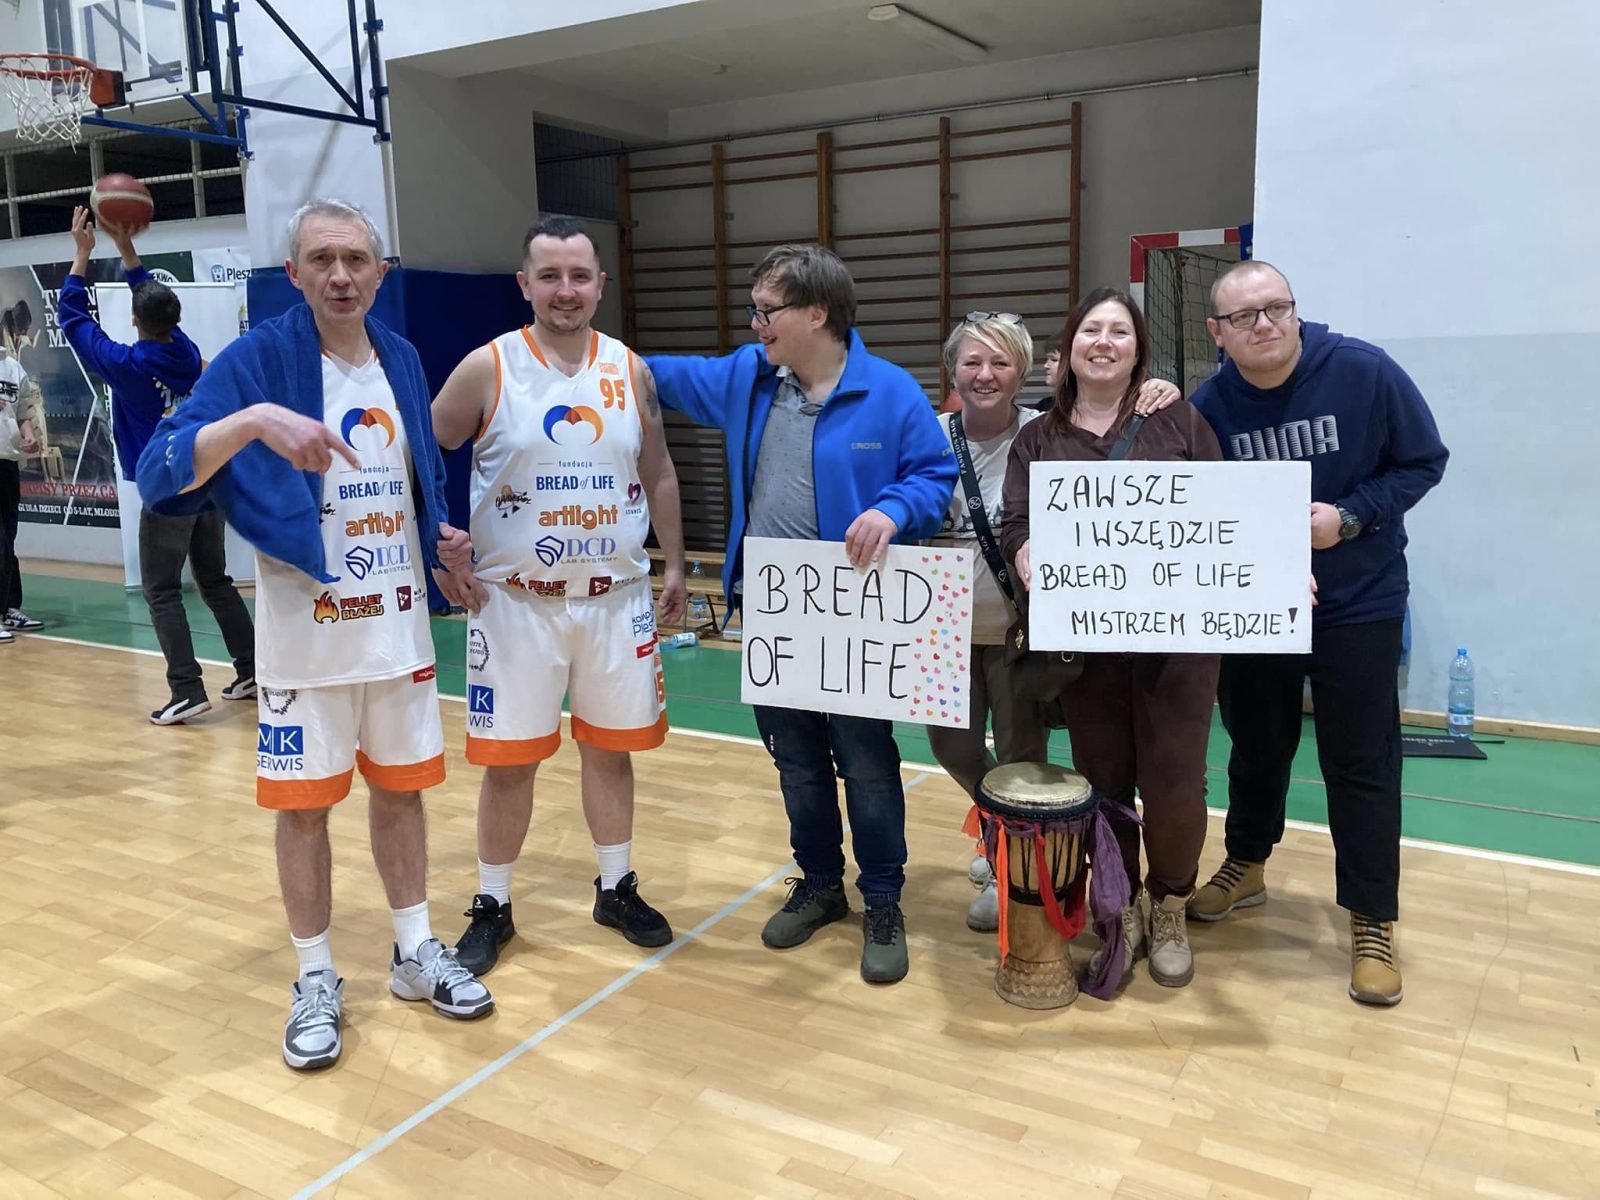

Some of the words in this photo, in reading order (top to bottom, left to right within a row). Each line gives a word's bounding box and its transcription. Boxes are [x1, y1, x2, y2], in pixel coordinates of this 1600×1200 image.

[227, 268, 251, 281] Plesz
[240, 321, 248, 330] AT
[599, 377, 625, 411] 95
[1229, 414, 1340, 461] PUMA
[559, 460, 593, 468] fundacja
[100, 484, 117, 499] CA
[339, 481, 380, 500] BREAD
[536, 475, 579, 490] BREAD
[580, 475, 591, 490] of
[592, 475, 615, 490] LIFE
[1047, 474, 1193, 512] ZAWSZE
[39, 504, 62, 514] DZIECI
[538, 504, 618, 530] artlight
[1075, 521, 1081, 547] I
[1091, 520, 1240, 550] WSZĘDZIE
[376, 544, 411, 567] DCD
[567, 537, 616, 557] DCD
[528, 580, 567, 591] PELLET
[1040, 563, 1127, 591] BREAD
[1152, 562, 1182, 588] OF
[1196, 563, 1255, 588] LIFE
[340, 594, 383, 609] PELLET
[756, 563, 933, 624] BREAD
[633, 621, 653, 637] Ples
[1071, 610, 1185, 636] MISTRZEM
[747, 636, 795, 687] OF
[820, 636, 911, 700] LIFE
[475, 689, 491, 711] K
[469, 714, 494, 729] WIS
